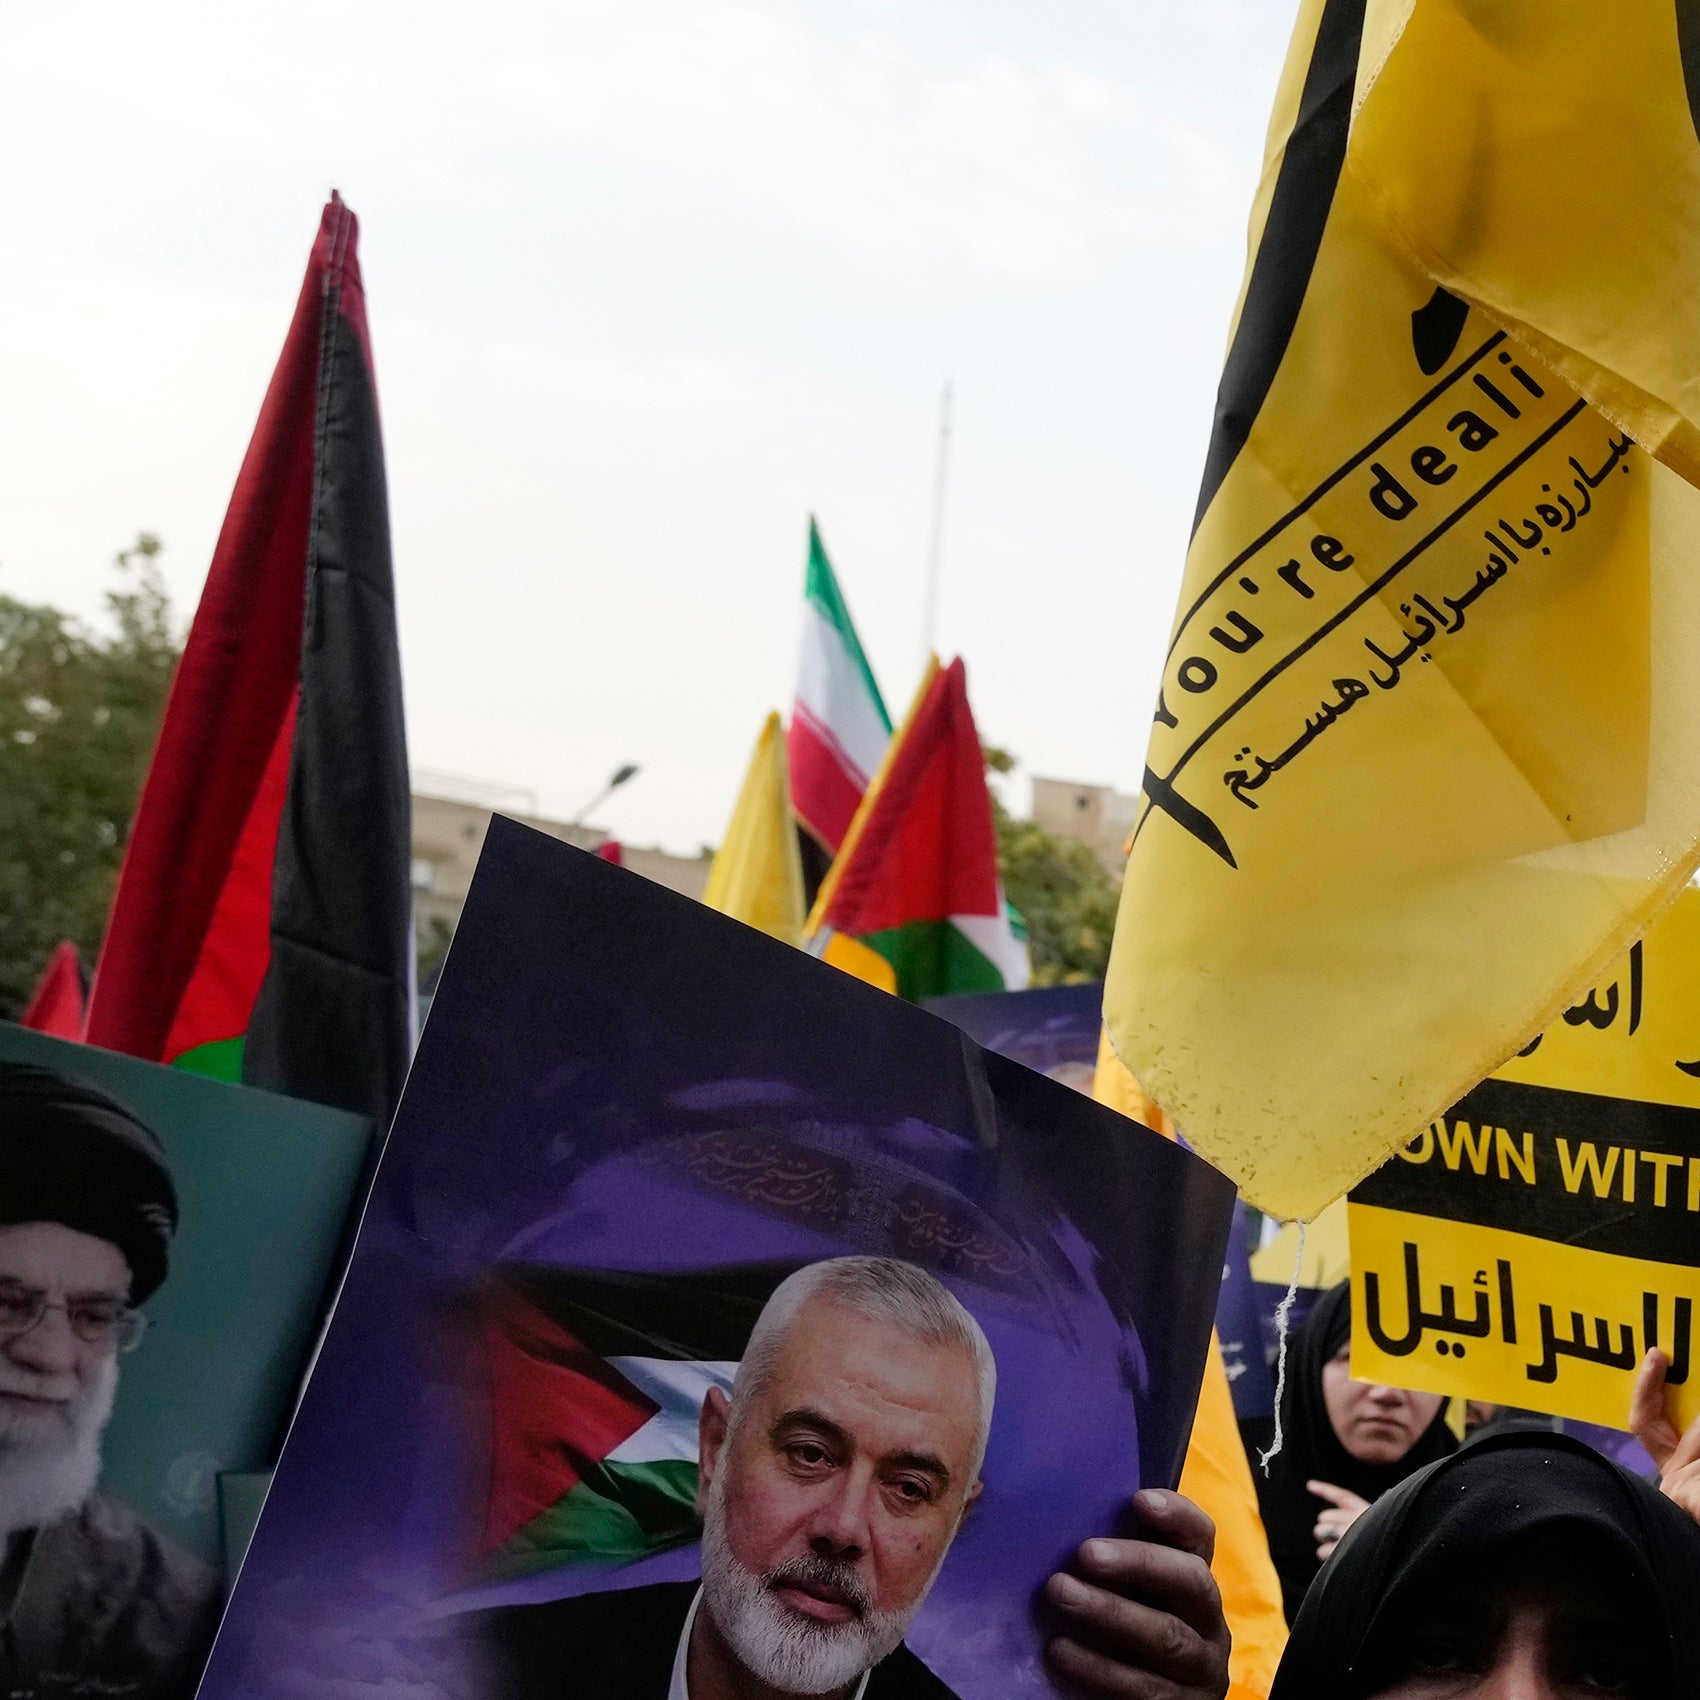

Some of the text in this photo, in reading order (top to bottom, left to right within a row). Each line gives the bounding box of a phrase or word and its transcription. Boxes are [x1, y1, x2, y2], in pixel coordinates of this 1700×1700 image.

[1369, 351, 1545, 521] deali
[1499, 518, 1551, 556] با
[1397, 1116, 1536, 1186] OWN
